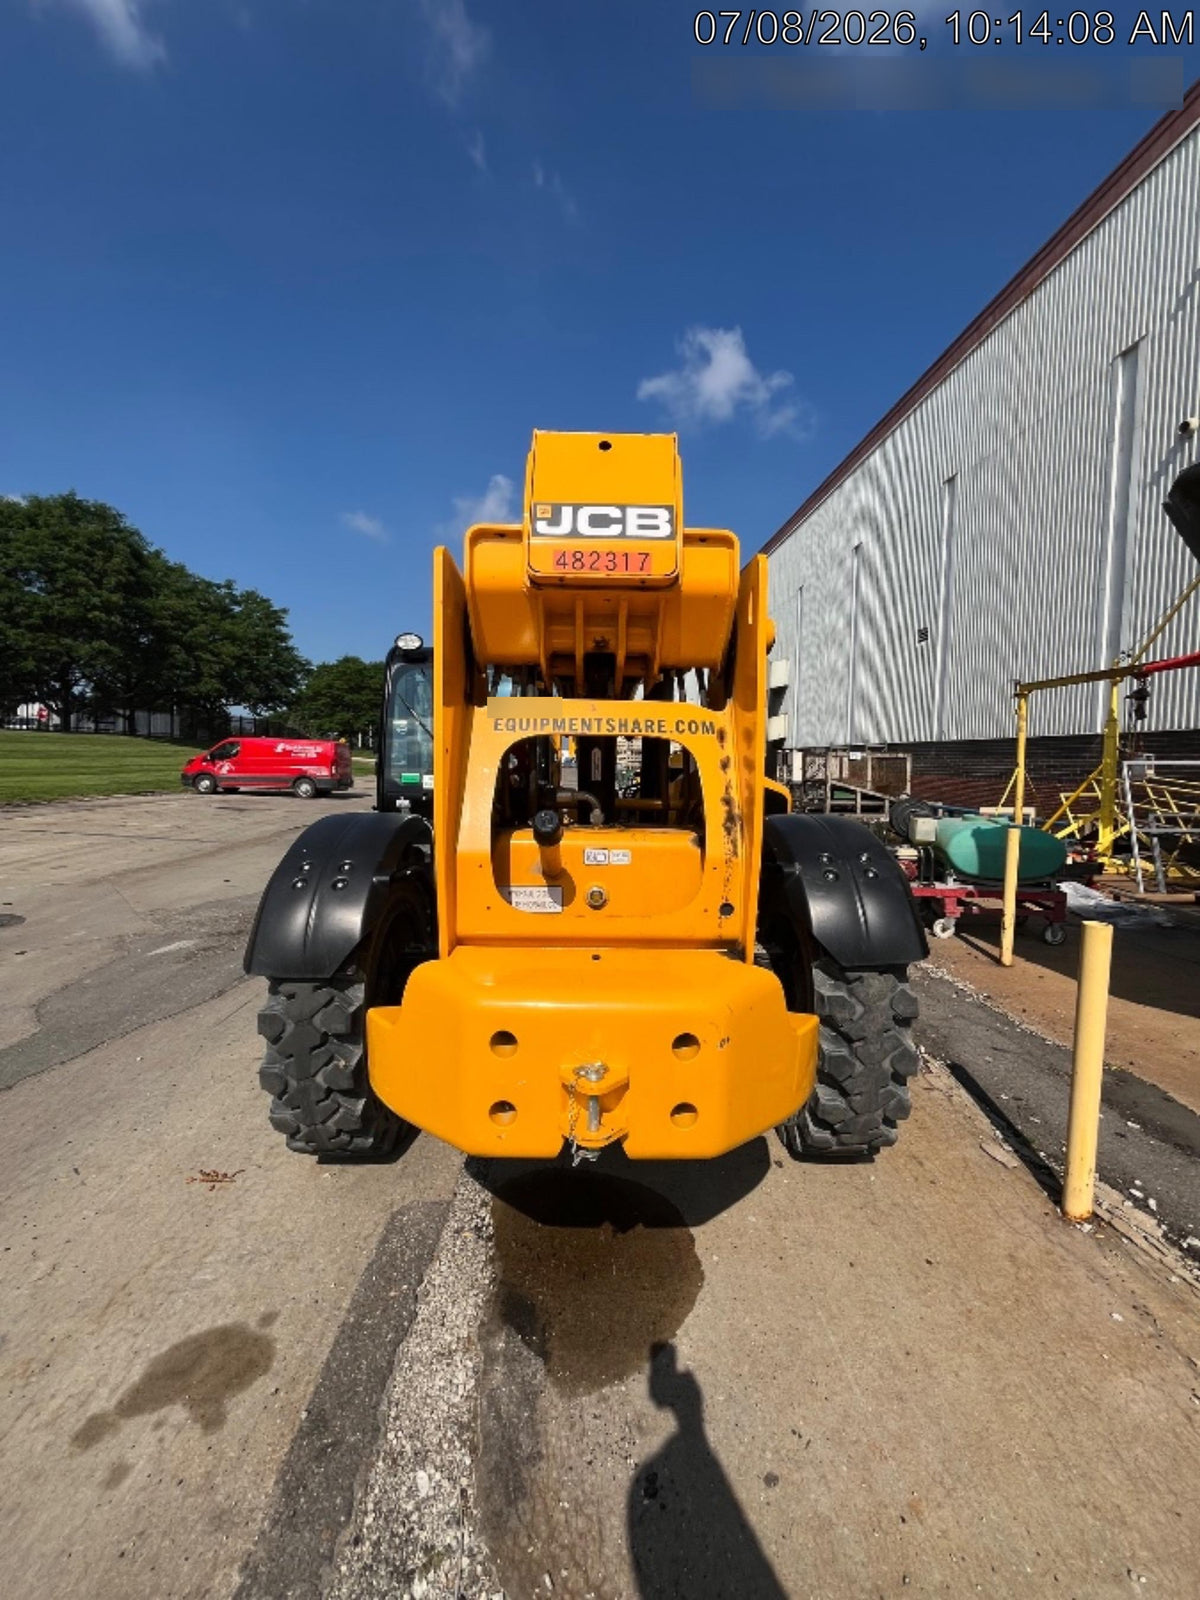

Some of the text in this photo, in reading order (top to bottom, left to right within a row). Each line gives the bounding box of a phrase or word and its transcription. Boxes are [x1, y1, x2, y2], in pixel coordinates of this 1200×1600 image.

[535, 505, 673, 538] JCB
[555, 550, 651, 572] 482317
[493, 717, 716, 736] EQUIPMENTSHARE.COM
